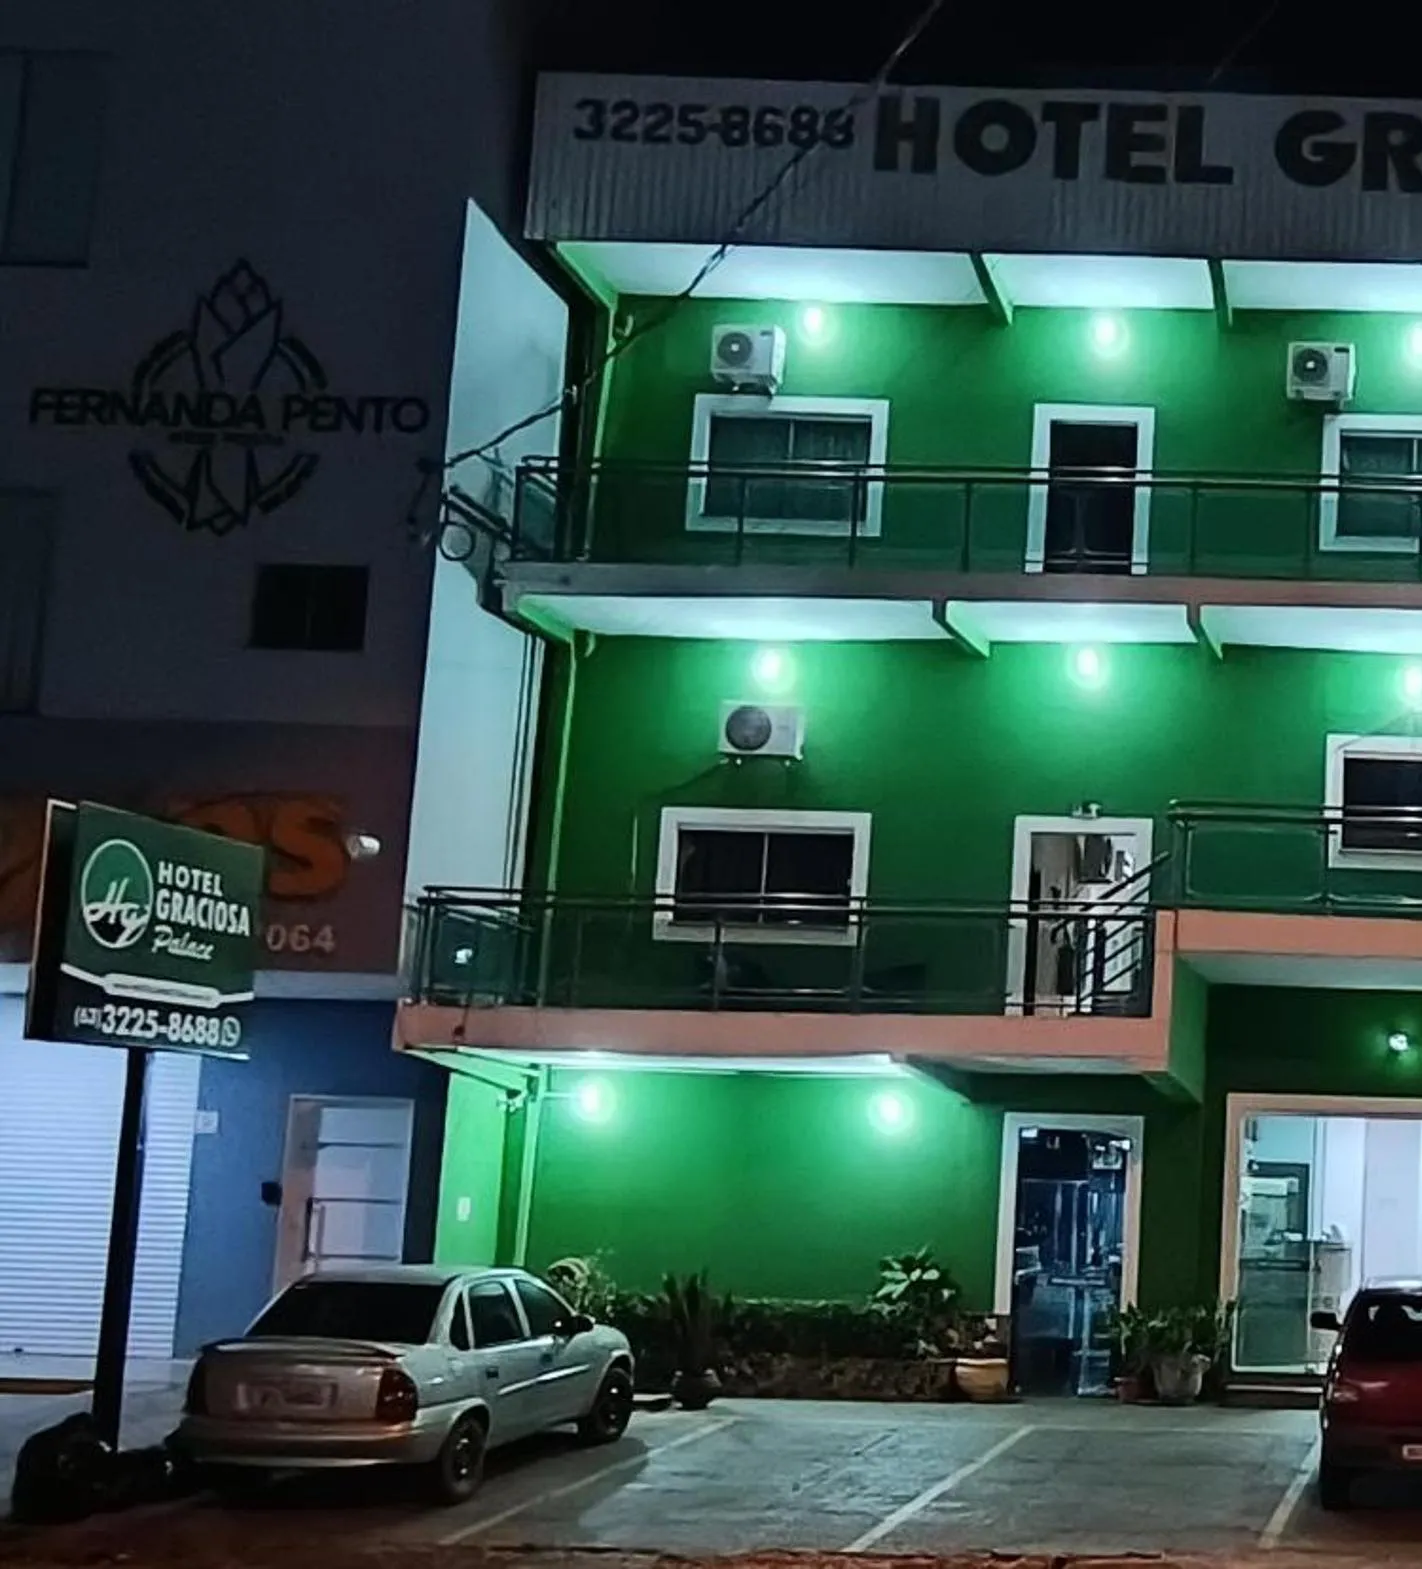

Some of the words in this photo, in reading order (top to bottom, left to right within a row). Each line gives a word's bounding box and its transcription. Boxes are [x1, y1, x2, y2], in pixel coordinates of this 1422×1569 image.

[574, 99, 855, 147] 3225-8688
[872, 93, 1233, 185] HOTEL
[30, 387, 265, 430] FERNANDA
[283, 394, 430, 433] PENTO
[157, 860, 223, 897] HOTEL
[155, 888, 250, 937] GRACIOSA
[151, 924, 215, 960] Palace
[101, 1003, 221, 1047] 3225-8688
